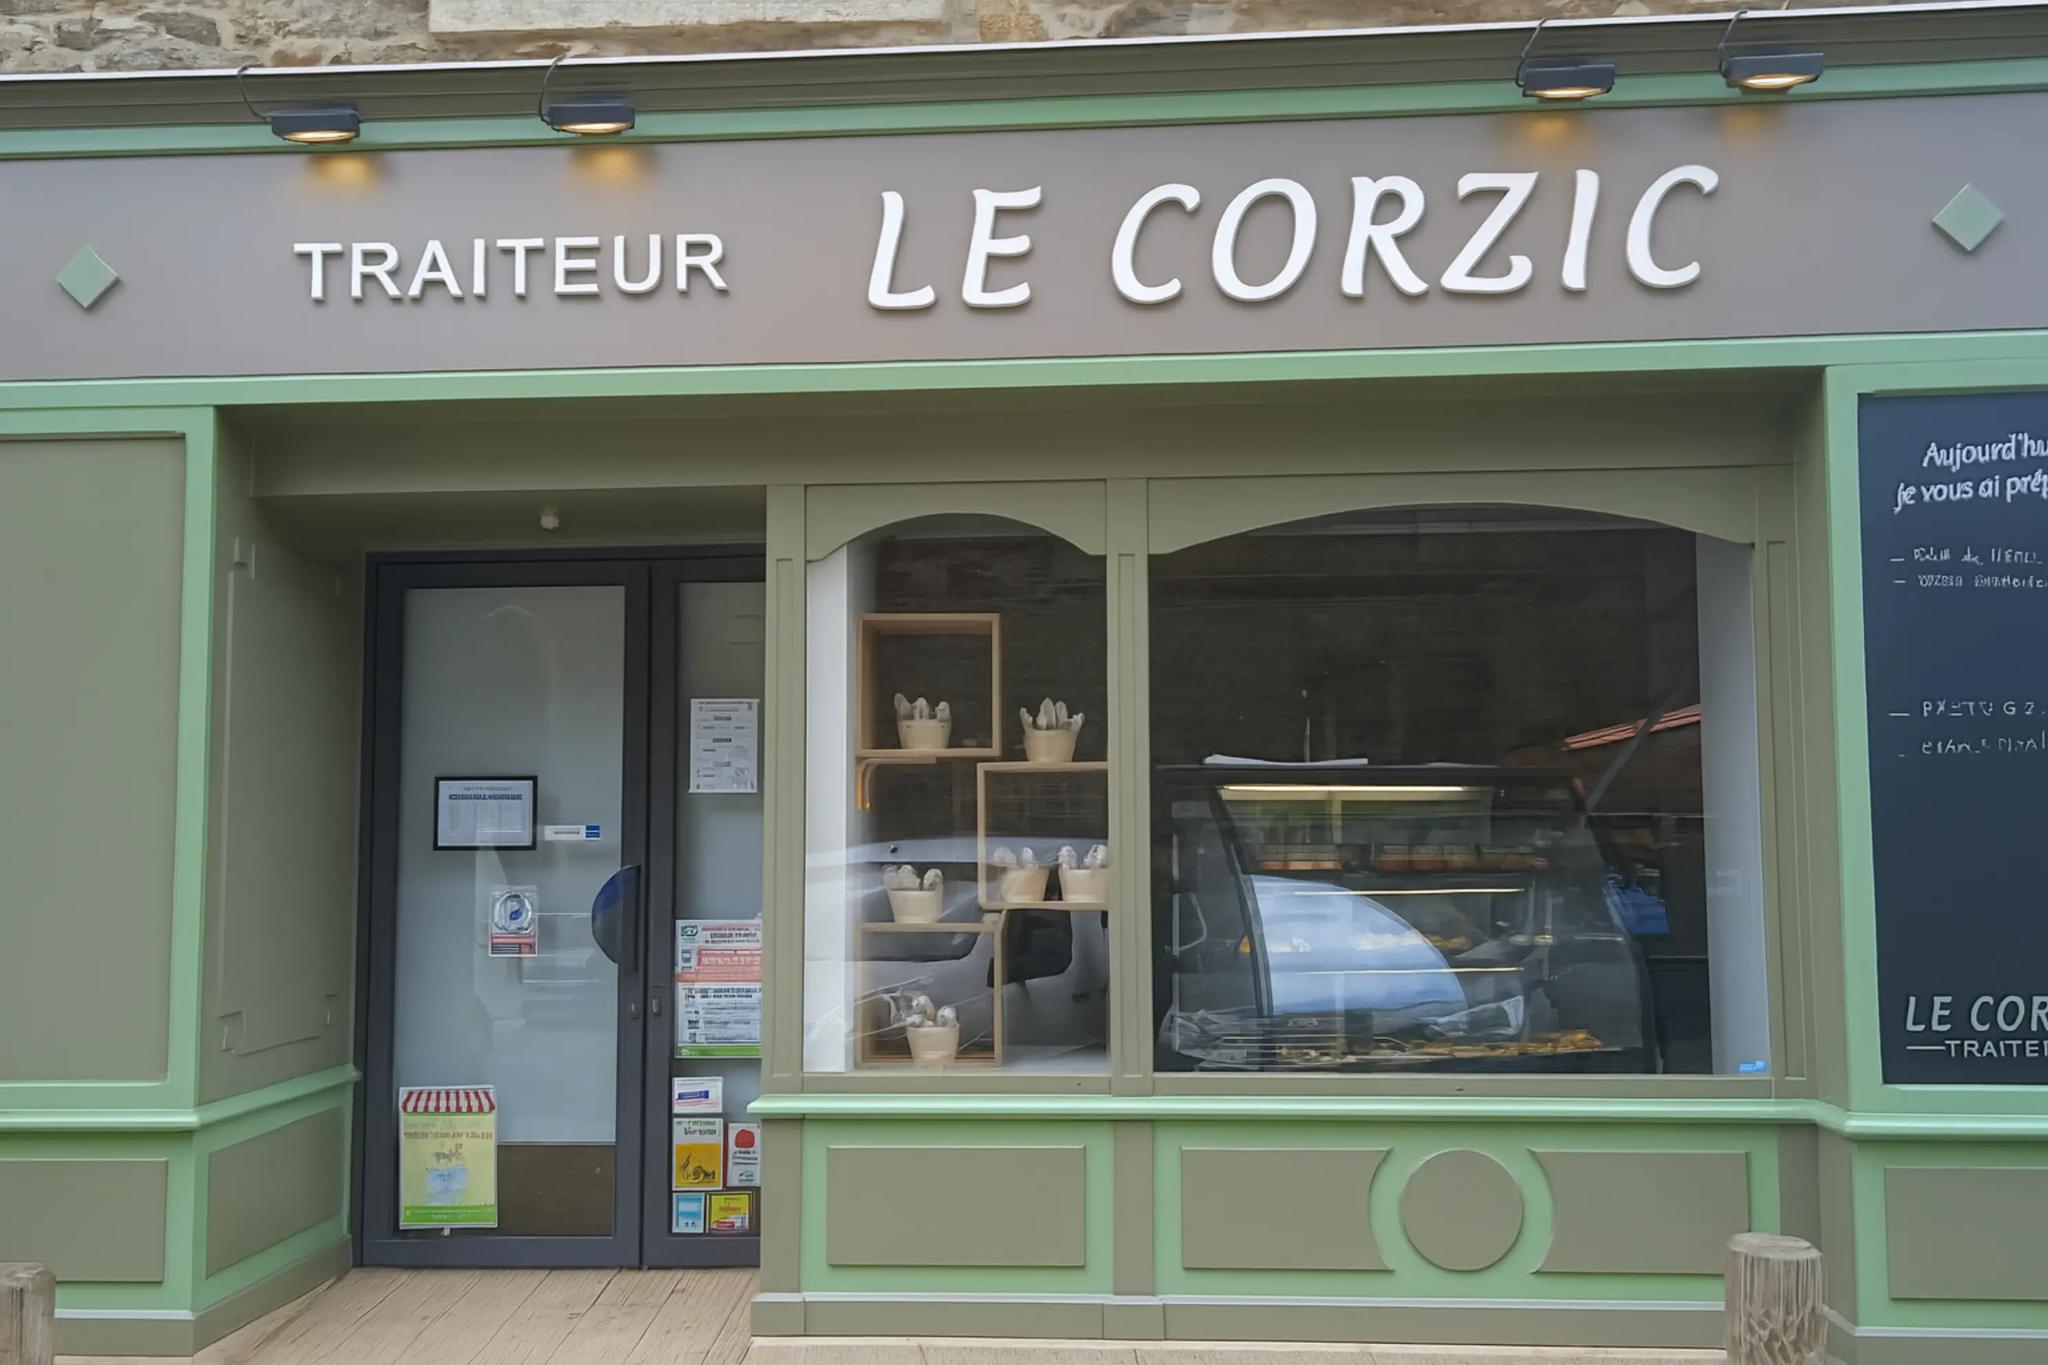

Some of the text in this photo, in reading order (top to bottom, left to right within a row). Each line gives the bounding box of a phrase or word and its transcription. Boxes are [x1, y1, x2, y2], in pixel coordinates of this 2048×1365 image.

[293, 163, 1721, 311] TRAITEUR LE CORZIC
[1921, 481, 1974, 503] vous
[1978, 475, 2000, 499] ai
[1906, 995, 2048, 1032] LE COR
